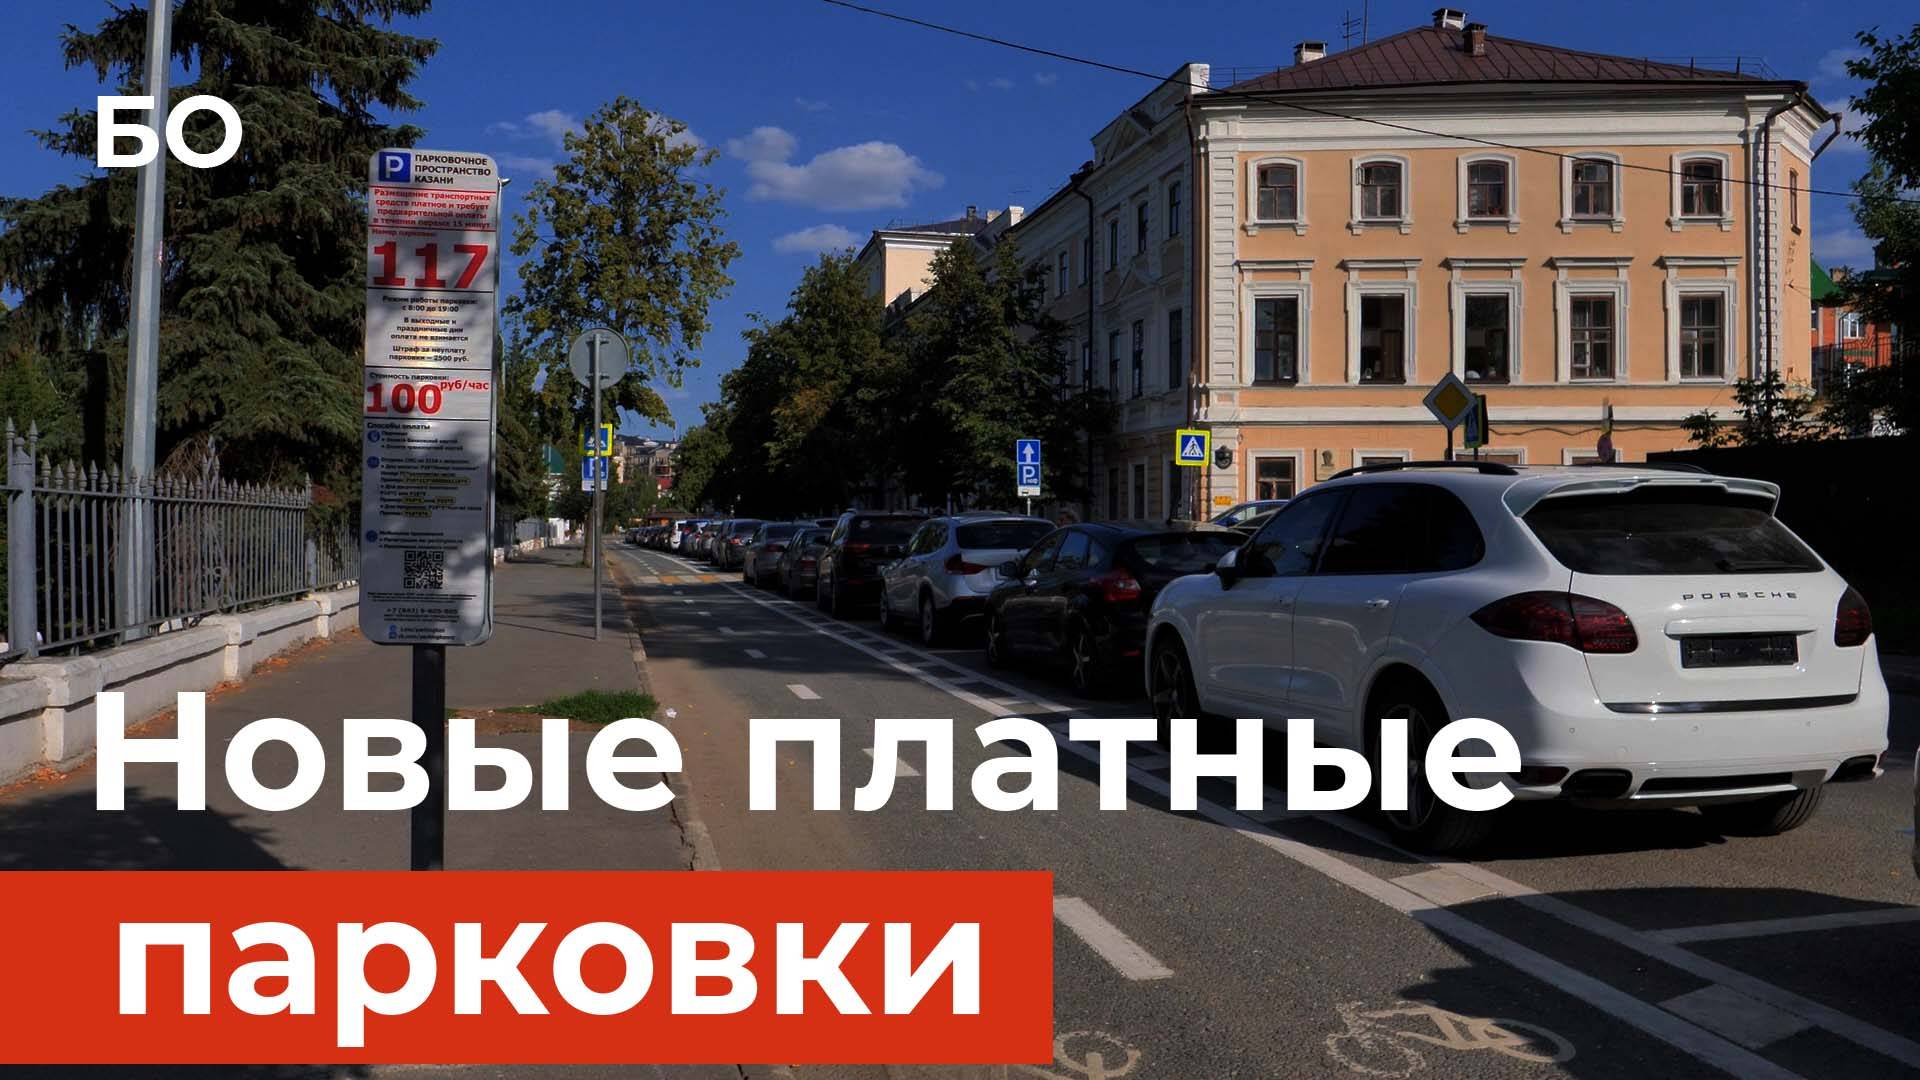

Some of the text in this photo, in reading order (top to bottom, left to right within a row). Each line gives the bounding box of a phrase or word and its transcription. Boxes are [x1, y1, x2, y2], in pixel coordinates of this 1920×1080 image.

[415, 154, 488, 166] ПАРКОВОЧНОЕ
[385, 155, 404, 179] P
[414, 165, 491, 176] ПРОСТРАНСТВО
[414, 175, 454, 184] КАЗАНИ
[374, 189, 490, 201] Размещение транспортных
[376, 199, 409, 207] средств
[377, 209, 454, 218] предварительной
[373, 241, 489, 288] 117
[393, 345, 420, 353] Штраф
[367, 380, 489, 414] 100 руб/час
[1023, 466, 1035, 484] P
[1682, 591, 1798, 600] PORSCHE
